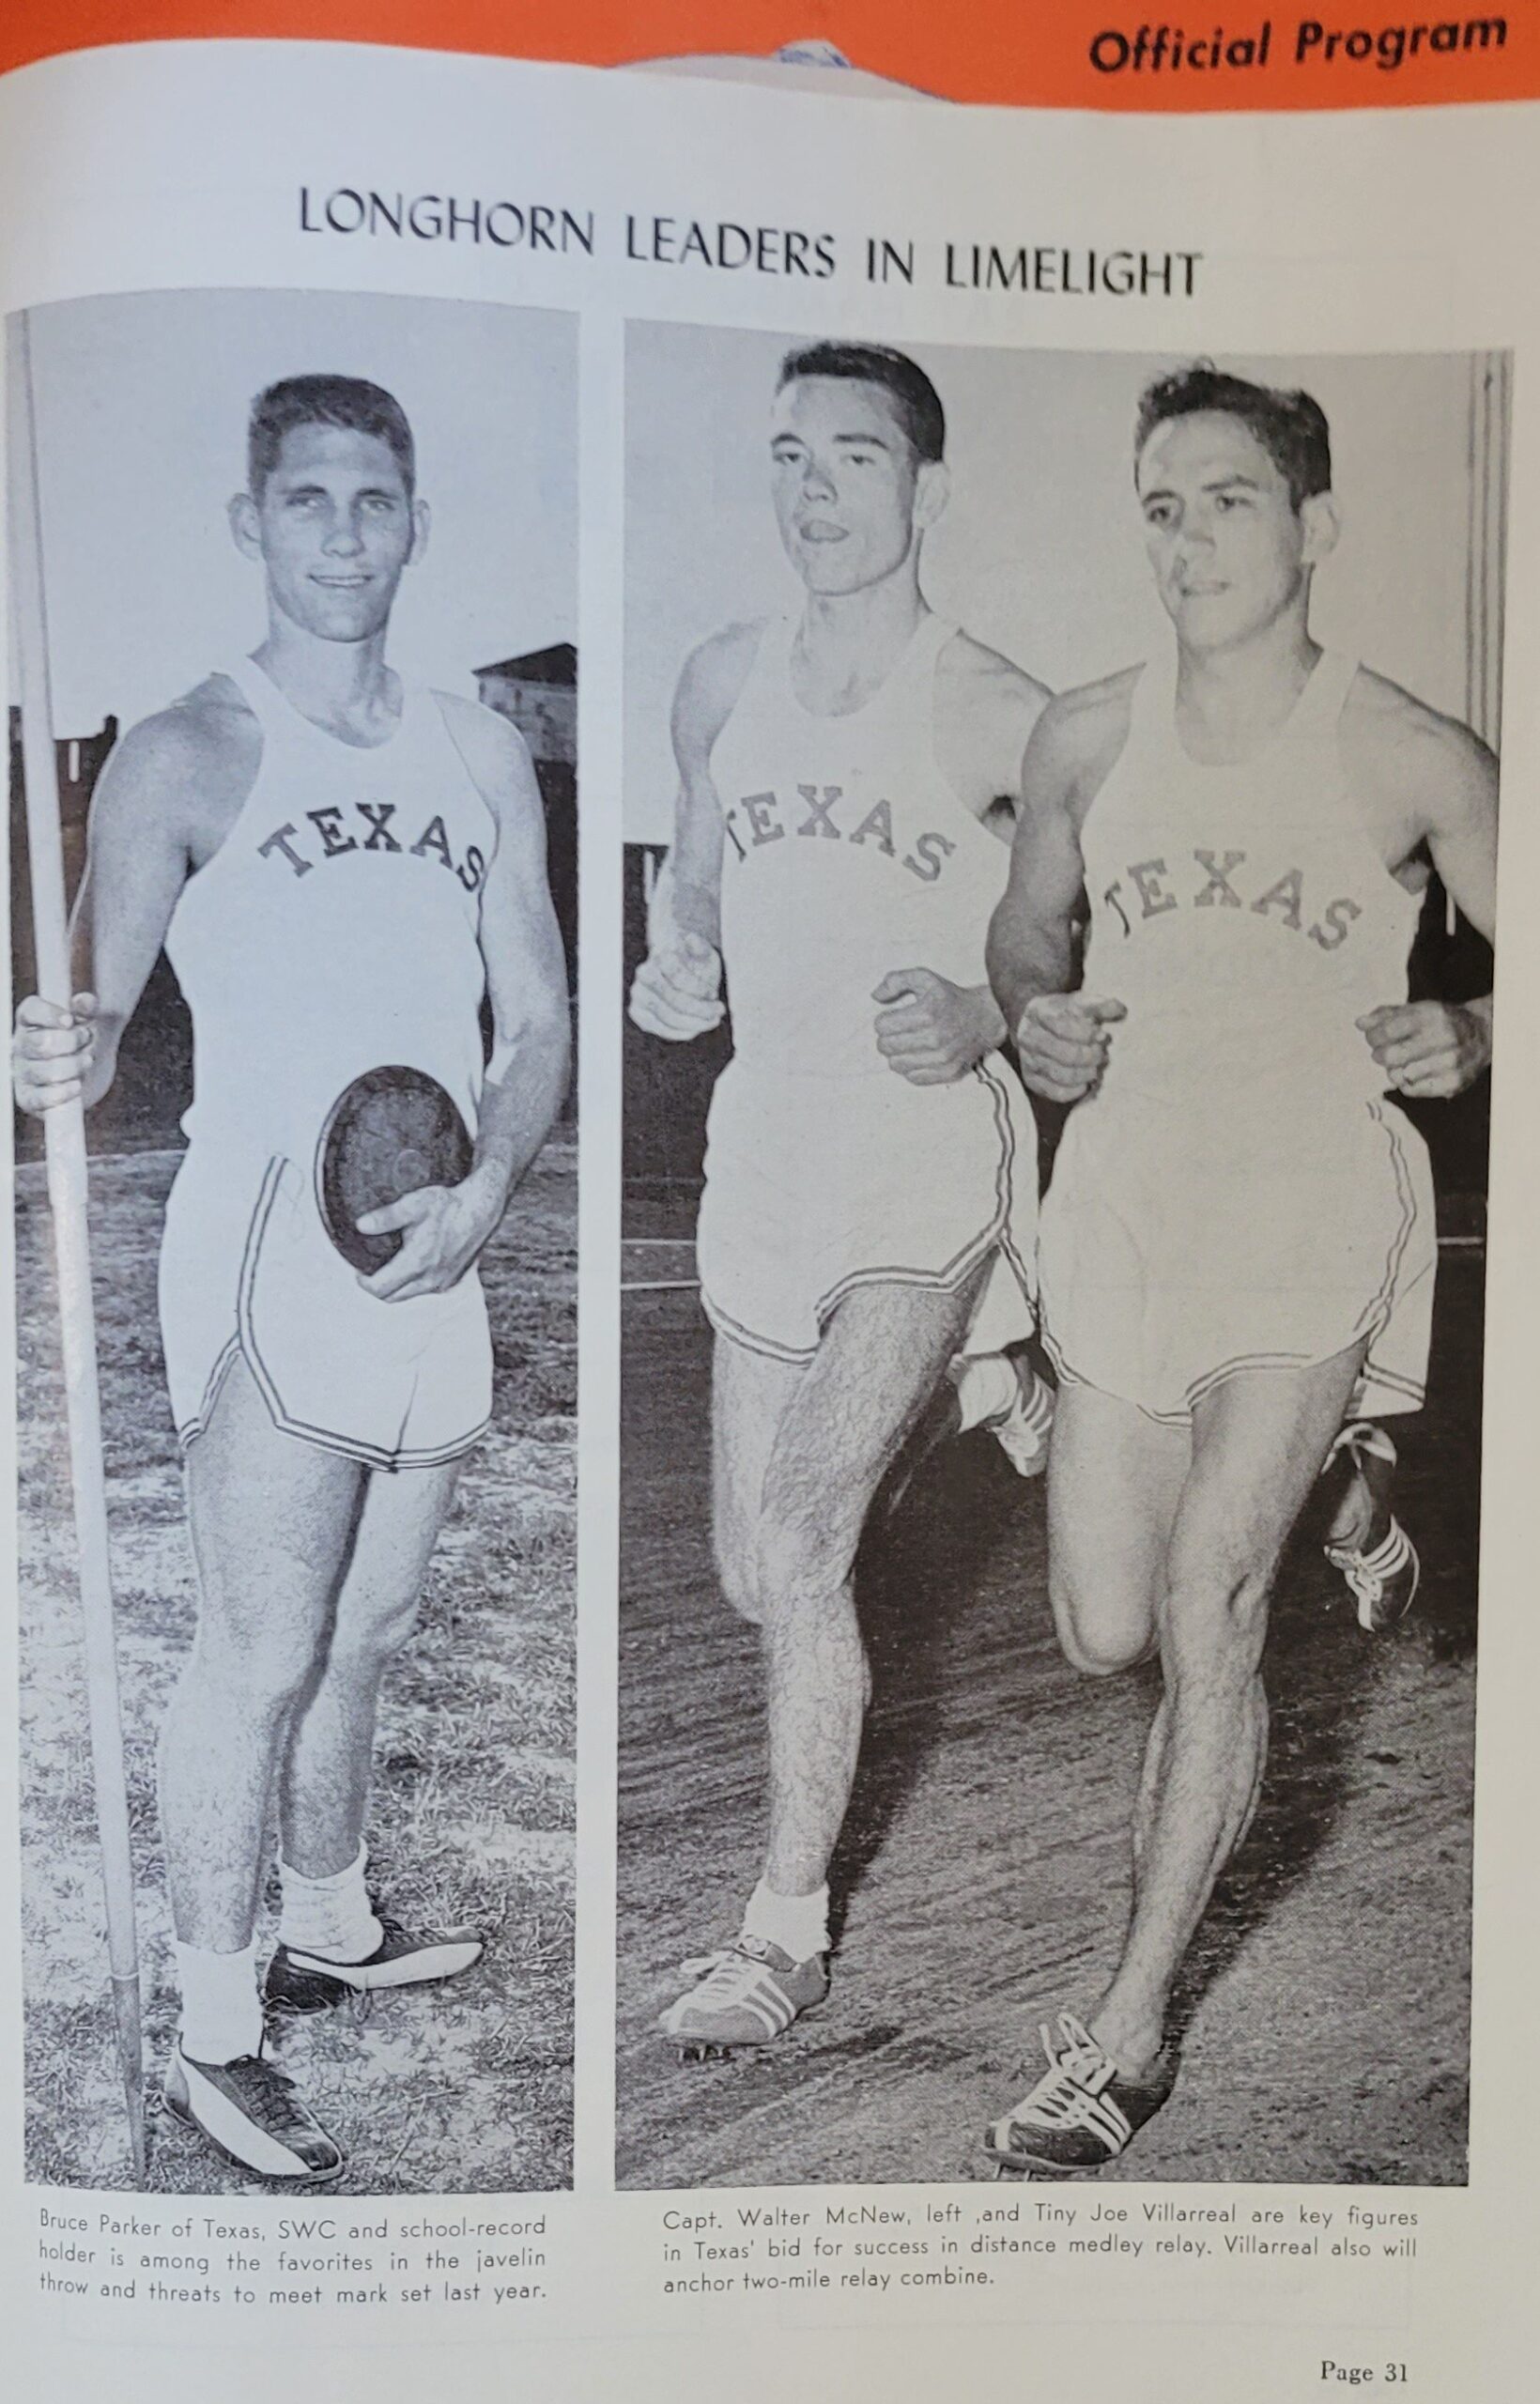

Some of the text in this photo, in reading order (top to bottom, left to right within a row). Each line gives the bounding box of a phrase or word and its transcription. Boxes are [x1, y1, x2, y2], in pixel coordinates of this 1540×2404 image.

[1088, 18, 1507, 73] Official Program
[300, 187, 1205, 297] LONGHORN LEADERS IN LIMELIGHT
[256, 801, 485, 893] TEXAS
[40, 2207, 546, 2242] Bruce Parker of Texas, SWC and school-record
[663, 2210, 722, 2234] Capt.
[737, 2207, 810, 2227] Walter
[826, 2205, 911, 2226] McNew,
[927, 2202, 962, 2223] left
[1034, 2202, 1077, 2227] Tiny
[1089, 2202, 1128, 2222] Joe
[1142, 2202, 1236, 2223] Villarreal
[1251, 2211, 1285, 2224] are
[1300, 2204, 1333, 2229] key
[1347, 2204, 1418, 2230] figures
[39, 2238, 546, 2275] holder is among the favorites in the javelin
[663, 2232, 1416, 2262] in Texas' bid for success in distance medley relay. Villarreal also will
[39, 2271, 547, 2305] throw and threats to meet mark set last year.
[663, 2265, 994, 2293] anchor two-mile relay combine.
[1320, 2360, 1408, 2385] Page 31
